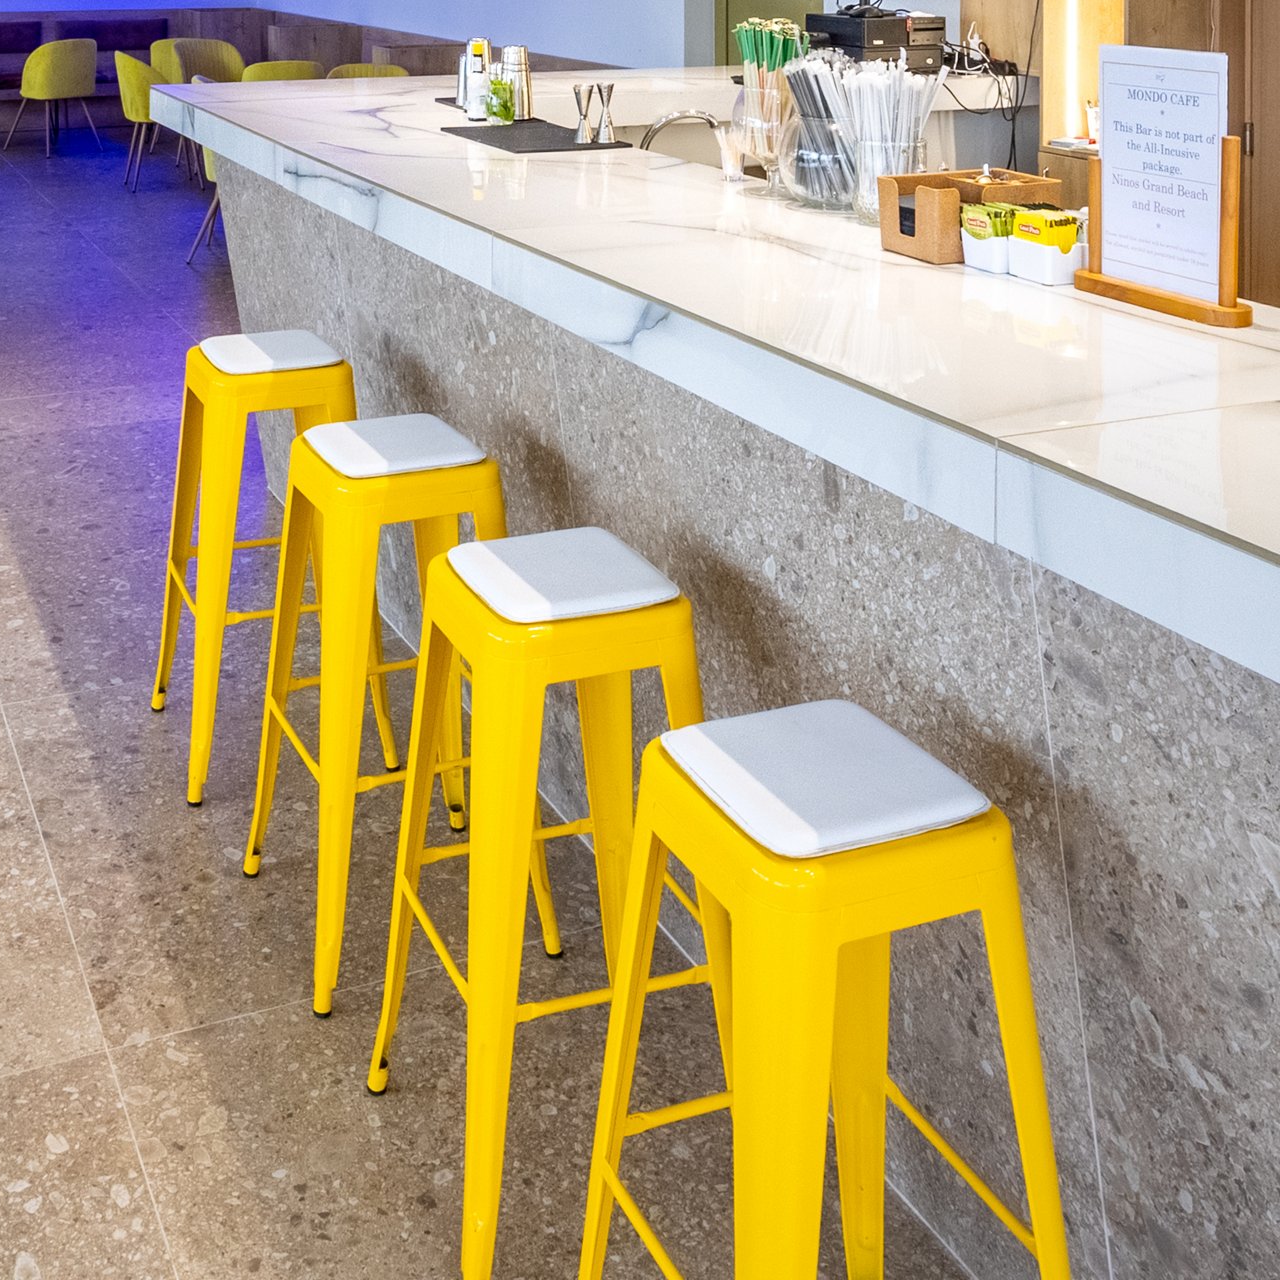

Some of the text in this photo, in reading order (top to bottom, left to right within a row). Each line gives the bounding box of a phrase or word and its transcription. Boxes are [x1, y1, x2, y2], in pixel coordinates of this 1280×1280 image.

[1127, 88, 1200, 108] MONDO CAFE
[1113, 120, 1216, 145] This Bar is not part of
[1127, 139, 1200, 160] the All-Incusive
[1142, 161, 1183, 176] package.
[1112, 173, 1209, 202] Ninos Grand Beach
[1132, 200, 1185, 218] and Resort
